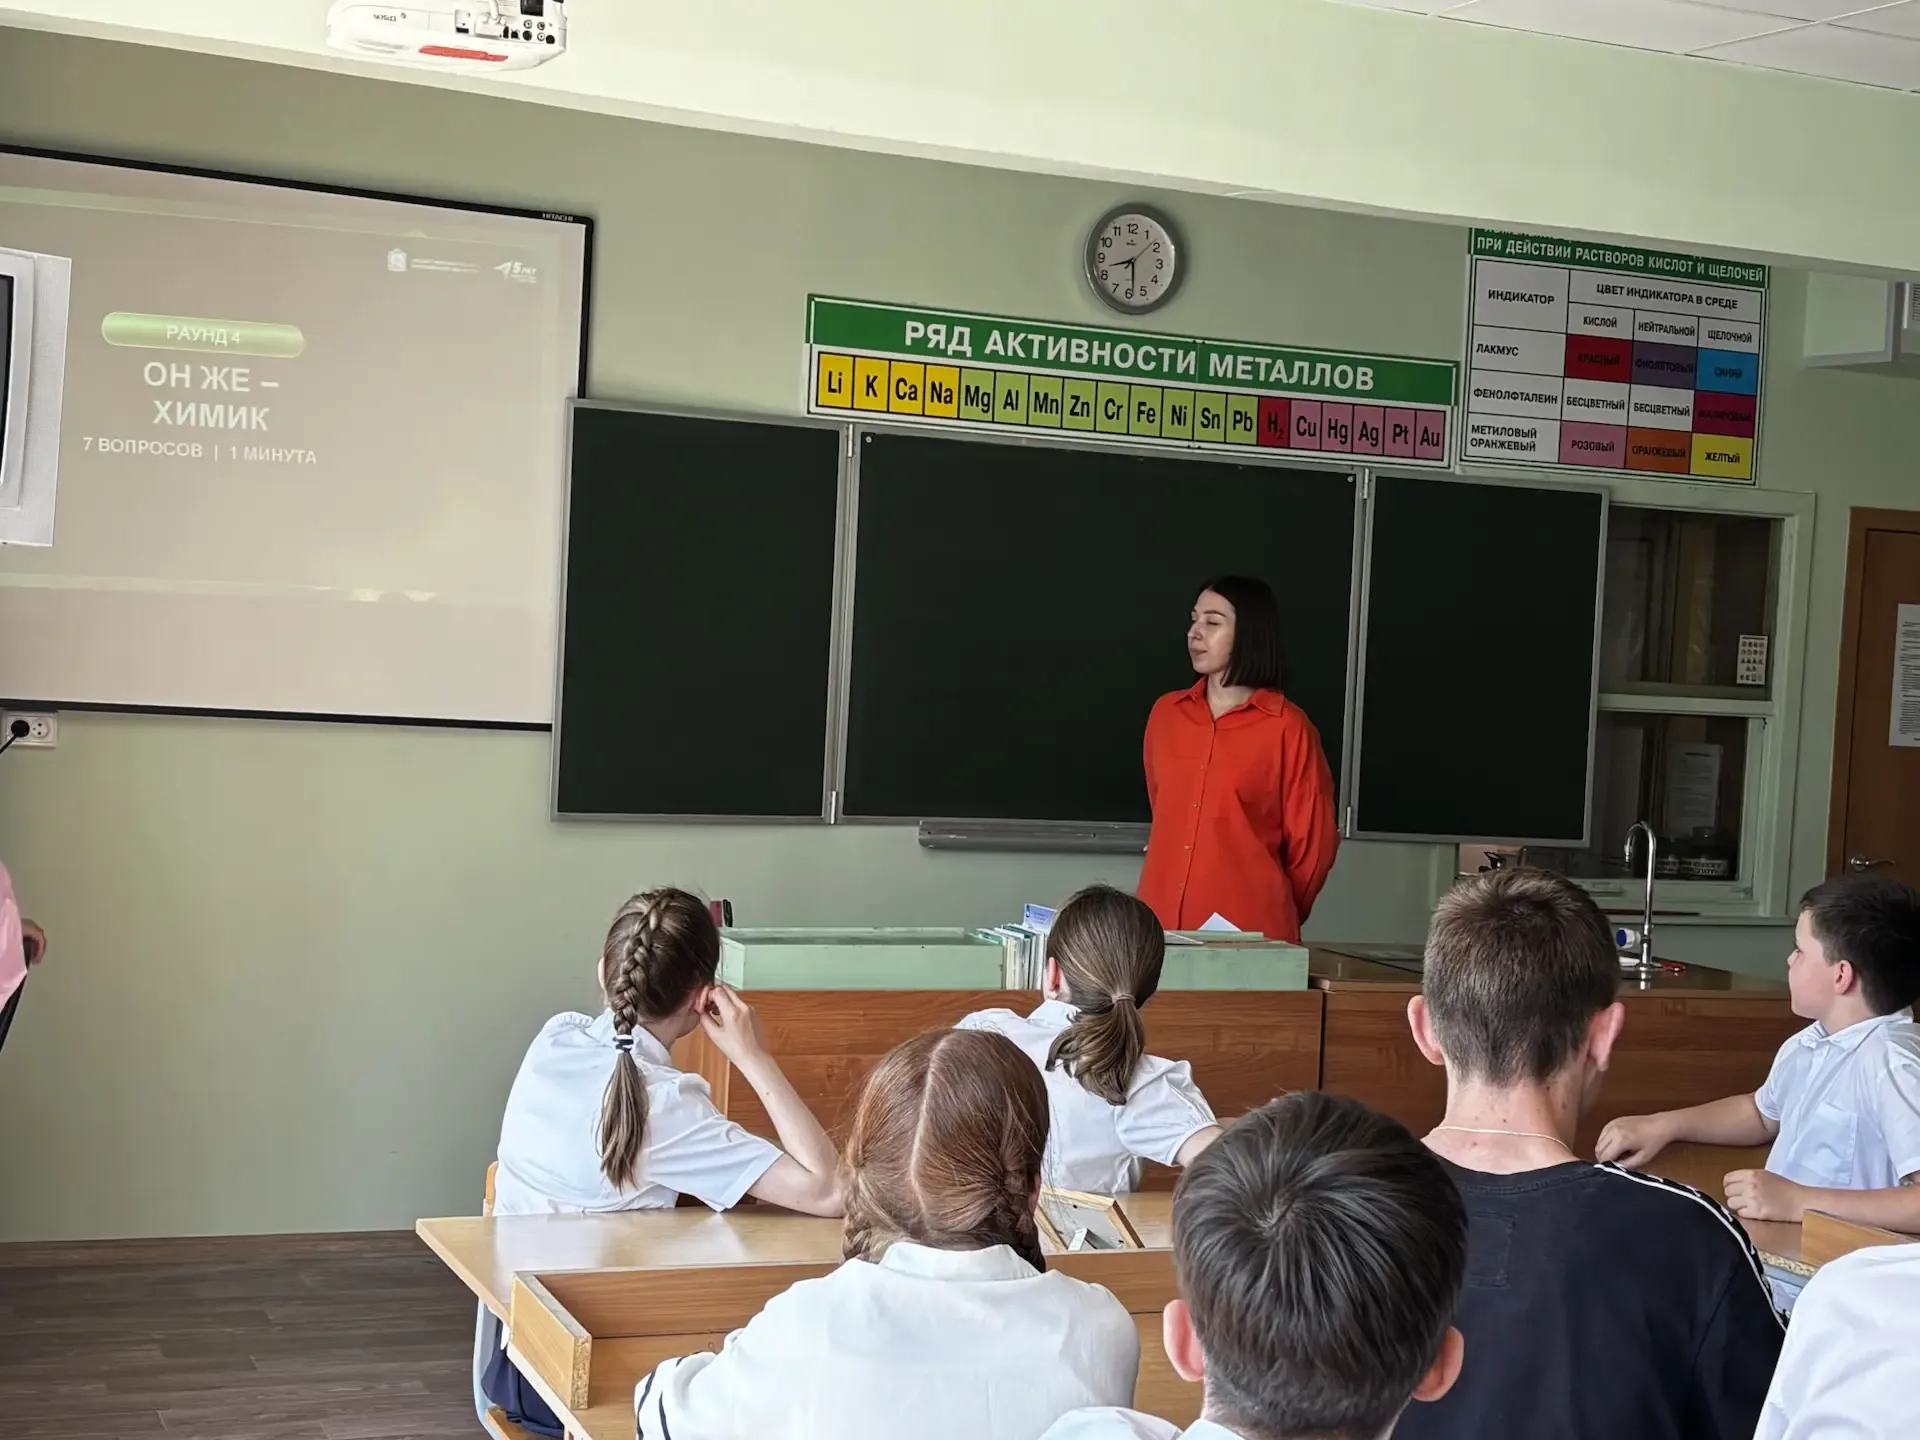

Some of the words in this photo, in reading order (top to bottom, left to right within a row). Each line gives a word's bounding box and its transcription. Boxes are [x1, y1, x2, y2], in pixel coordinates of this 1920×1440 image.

[1112, 226, 1121, 236] 11
[1127, 223, 1138, 235] 12
[1144, 230, 1149, 240] 1
[1100, 237, 1112, 248] 10
[1152, 242, 1160, 253] 2
[1097, 252, 1105, 263] 9
[1155, 258, 1163, 269] 3
[1477, 236, 1502, 250] ПРИ
[1505, 239, 1571, 258] ДЕЙСТВИИ
[1575, 248, 1644, 267] РАСТВОРОВ
[1648, 256, 1694, 273] КИСЛОТ
[1697, 263, 1705, 275] И
[1708, 263, 1763, 282] ЩЕЛОЧЕЙ
[1100, 269, 1108, 280] 8
[1150, 274, 1158, 285] 4
[1112, 282, 1119, 294] 7
[1125, 288, 1133, 300] 6
[1140, 285, 1147, 296] 5
[1488, 289, 1555, 305] ИНДИКАТОР
[1596, 283, 1624, 297] ЦВЕТ
[1626, 287, 1694, 304] ИНДИКАТОРА
[1696, 295, 1703, 304] В
[1705, 296, 1738, 310] СРЕДЕ
[1583, 315, 1617, 328] КИСЛОЙ
[166, 324, 228, 347] РАУНД
[231, 330, 241, 344] 4
[1638, 321, 1695, 337] НЕЙТРАЛЬНОЙ
[1707, 329, 1752, 343] ЩЕЛОЧНОЙ
[905, 320, 972, 358] РЯД
[984, 329, 1196, 376] АКТИВНОСТИ
[1208, 353, 1375, 391] МЕТАЛЛОВ
[1475, 343, 1519, 356] ЛАКМУС
[143, 361, 191, 388] ОН
[200, 365, 251, 392] ЖЕ
[1473, 388, 1558, 405] ФЕНОЛФТАЛЕИН
[1566, 396, 1625, 410] БЕСЦВЕТНЫЙ
[153, 400, 270, 431] ХИМИК
[828, 370, 843, 394] Li
[865, 375, 878, 398] K
[895, 377, 918, 401] Ca
[931, 381, 954, 405] Na
[964, 385, 991, 413] Mg
[1003, 389, 1019, 411] Al
[1033, 391, 1059, 415] Mn
[1069, 395, 1090, 418] Zn
[1104, 398, 1123, 421] Cr
[1137, 401, 1156, 424] Fe
[1171, 404, 1187, 427] Ni
[1200, 407, 1220, 429] Sn
[1233, 409, 1253, 432] Pb
[1296, 415, 1316, 437] Cu
[1327, 418, 1348, 444] Hg
[1358, 421, 1379, 447] Ag
[1392, 424, 1408, 445] Pt
[1419, 426, 1440, 448] Au
[1633, 402, 1690, 417] БЕСЦВЕТНЫЙ
[1471, 424, 1537, 439] МЕТИЛОВЫЙ
[83, 437, 93, 451] 7
[98, 438, 203, 458] ВОПРОСОВ
[229, 446, 236, 459] 1
[244, 446, 317, 464] МИНУТА
[1470, 438, 1536, 452] ОРАНЖЕВЫЙ
[1571, 439, 1614, 453] РОЗОВЫЙ
[1705, 451, 1740, 464] ЖЕЛТЫЙ
